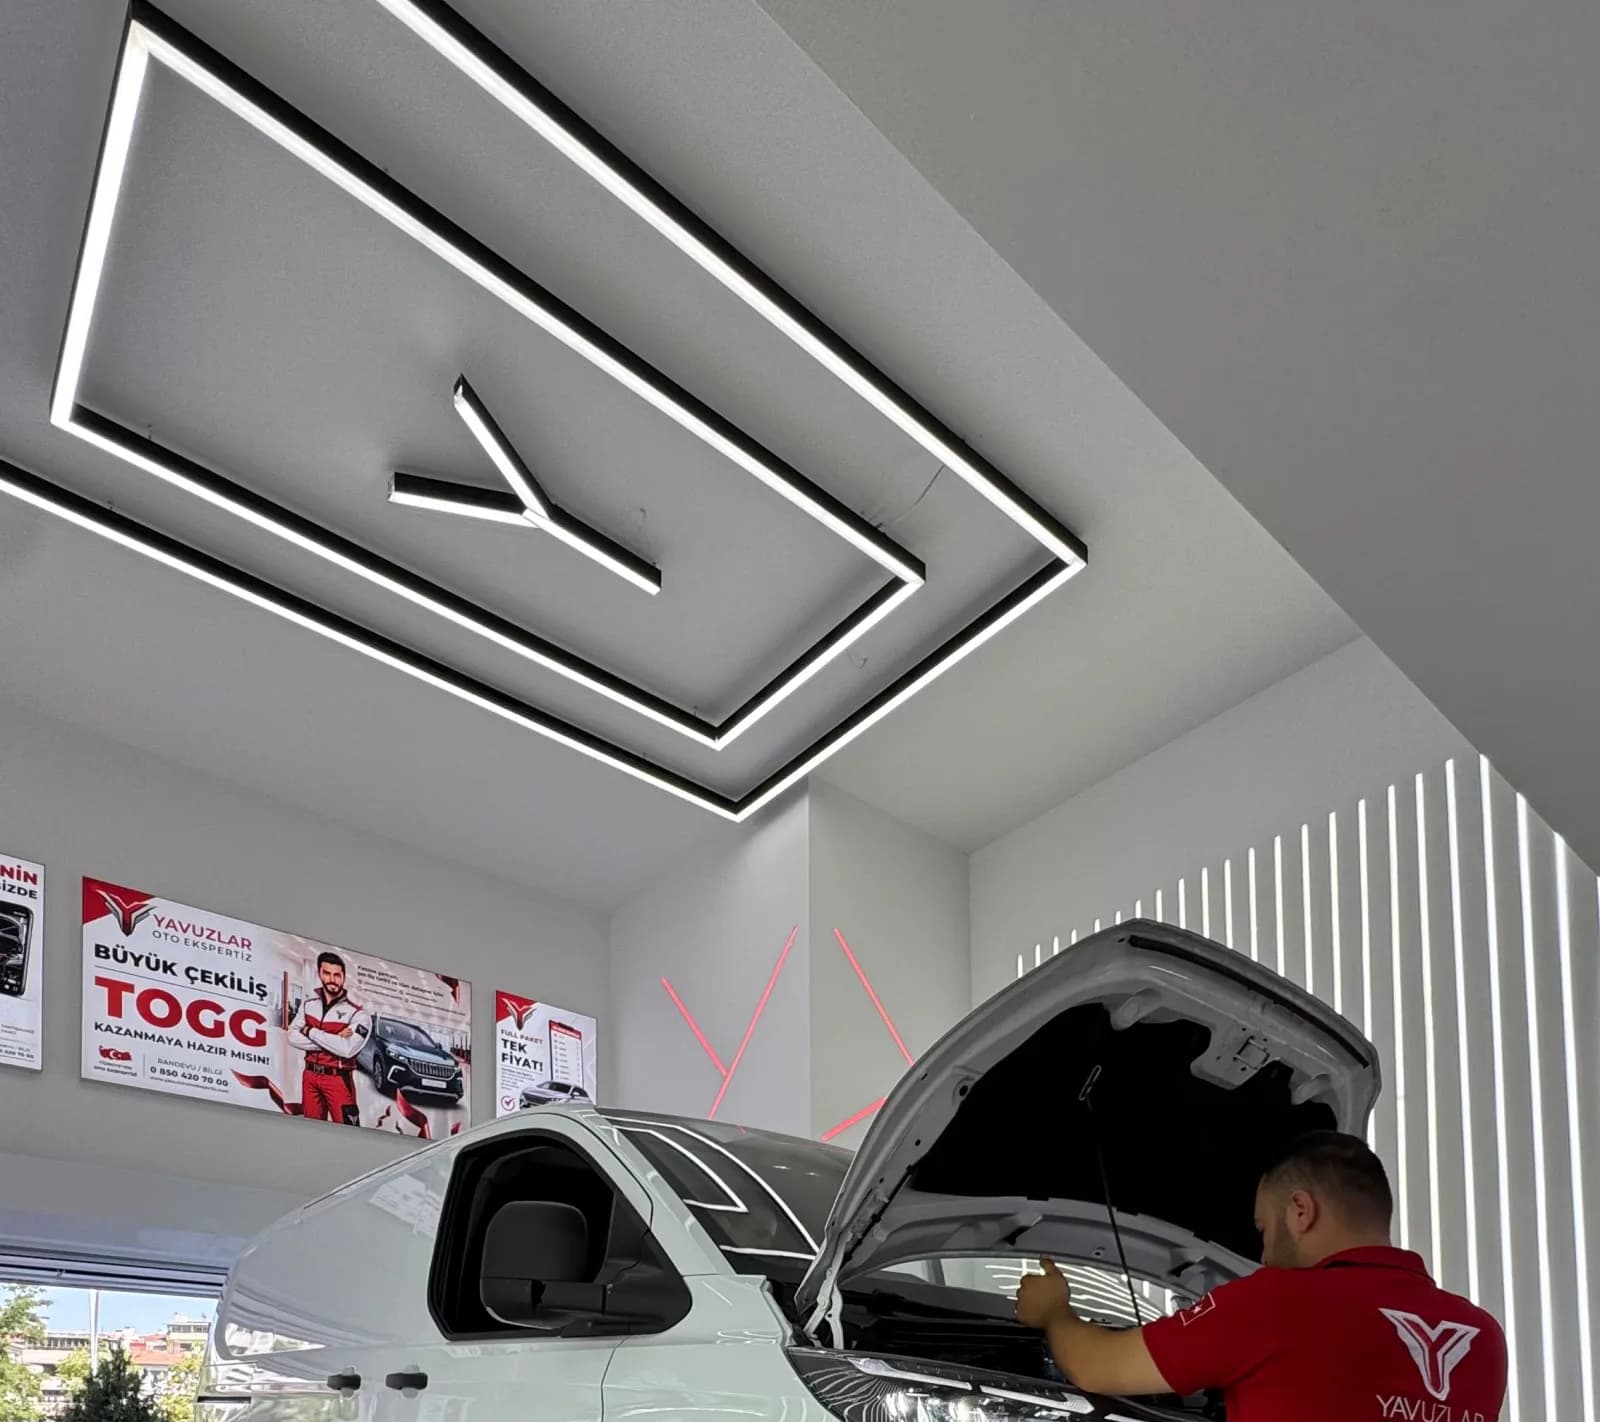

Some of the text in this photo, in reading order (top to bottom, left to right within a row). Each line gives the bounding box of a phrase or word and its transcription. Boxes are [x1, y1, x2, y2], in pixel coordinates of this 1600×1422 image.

[0, 880, 37, 899] İZDE
[153, 914, 252, 950] YAVUZLAR
[152, 930, 252, 962] OTO EKSPERTİZ
[94, 943, 268, 1000] BÜYÜK ÇEKİLİŞ
[94, 975, 267, 1047] TOGG
[94, 1021, 270, 1065] KAZANMAYA HAZIR MISIN!
[501, 1038, 527, 1054] TEK
[158, 1058, 196, 1071] RANDEVU
[501, 1051, 543, 1072] FİYAT!
[159, 1068, 178, 1077] 850
[181, 1072, 199, 1081] 420
[201, 1076, 214, 1084] 70
[215, 1078, 229, 1087] 00
